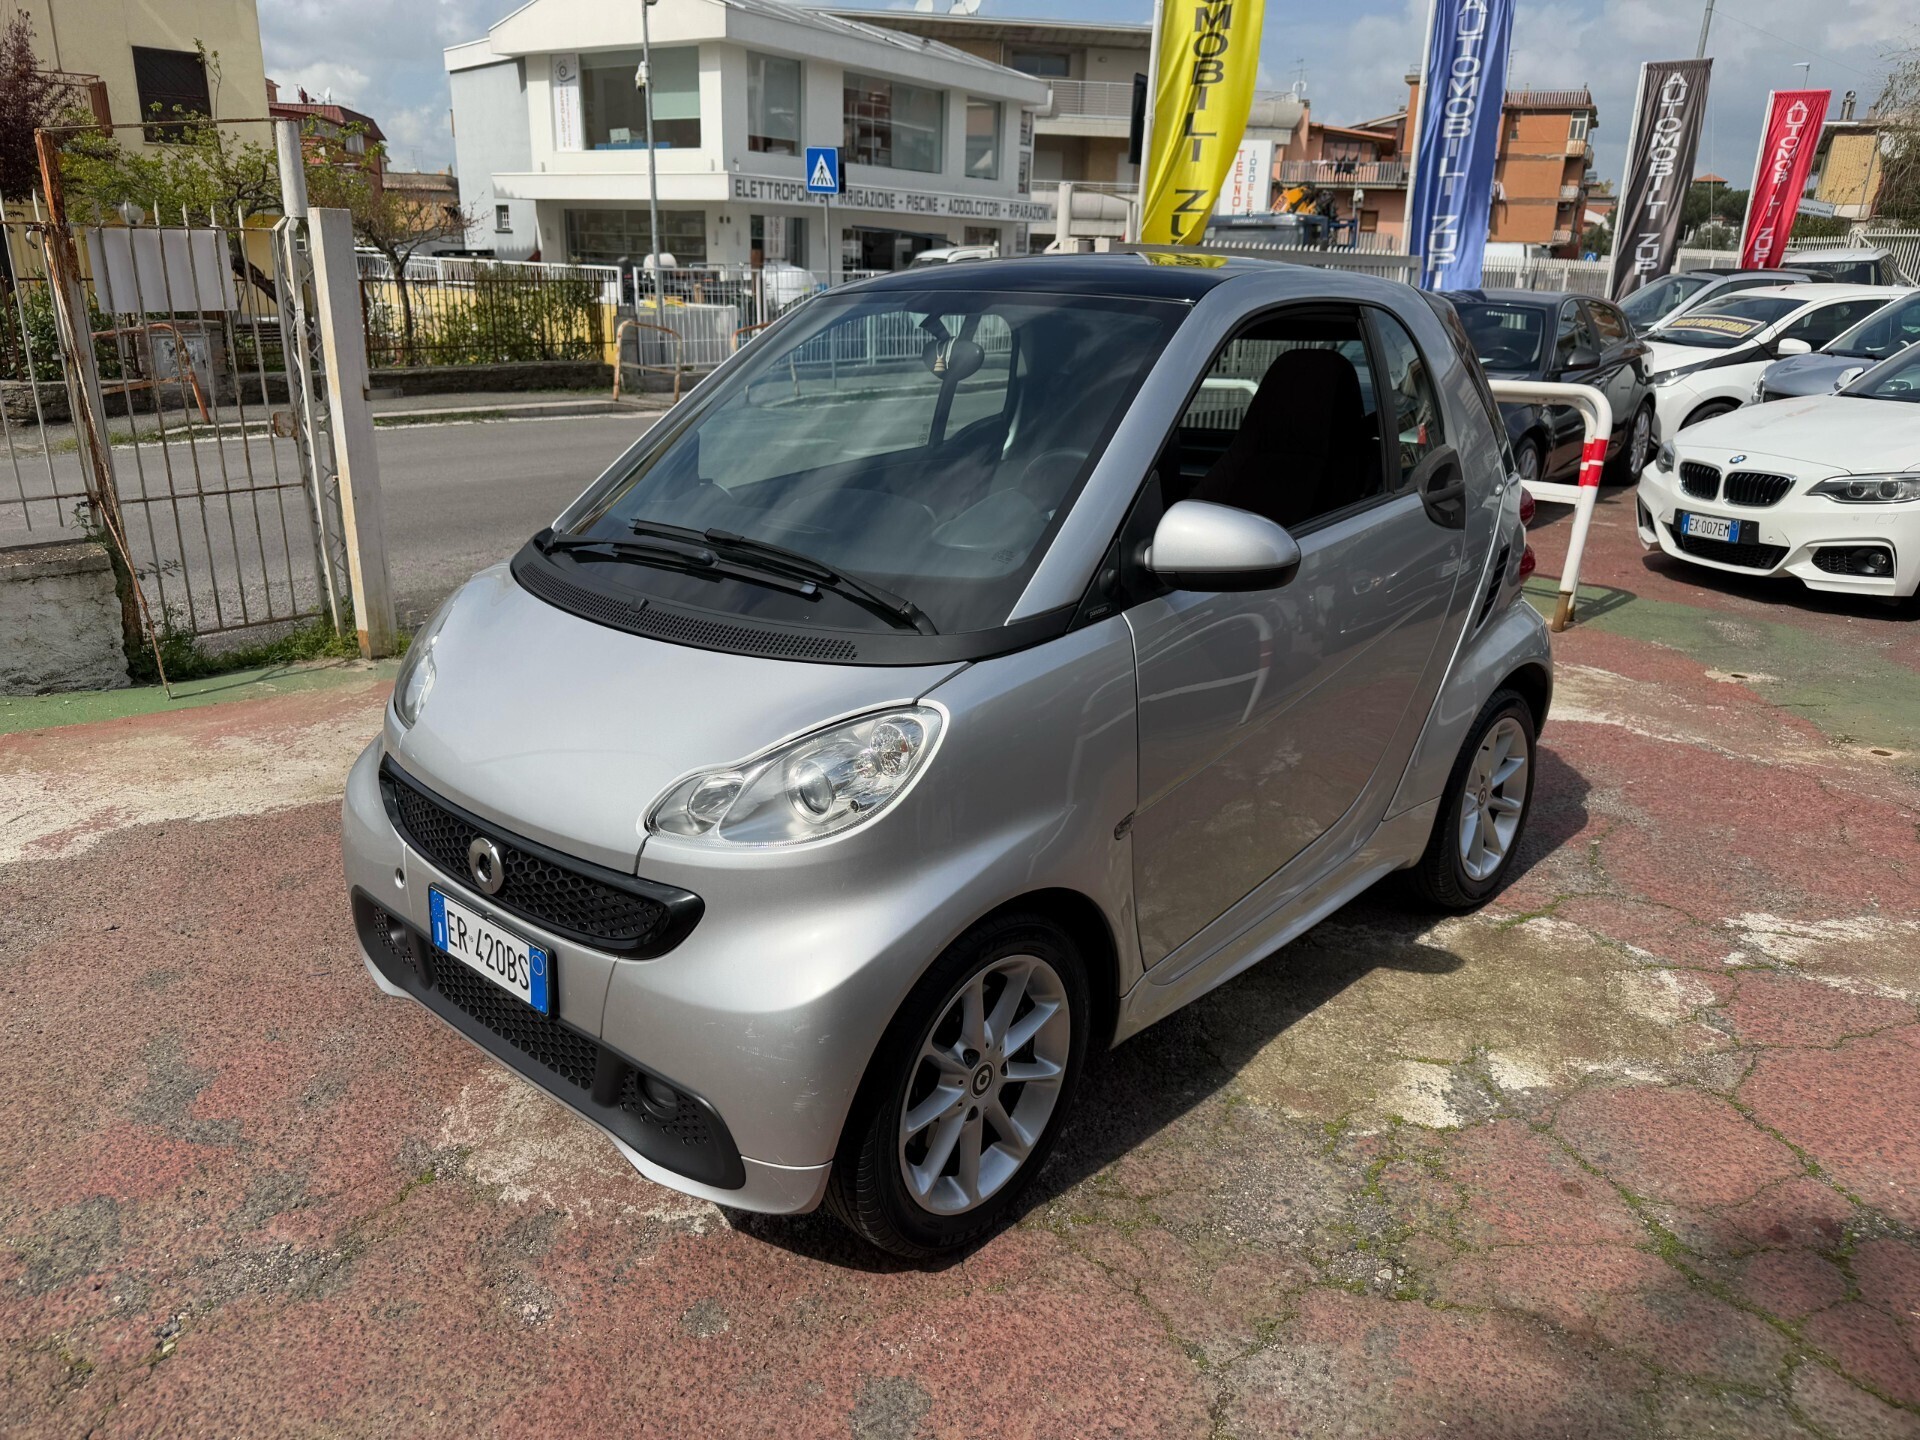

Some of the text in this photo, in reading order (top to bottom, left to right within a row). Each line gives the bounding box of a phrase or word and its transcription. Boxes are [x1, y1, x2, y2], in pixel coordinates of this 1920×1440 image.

[1170, 0, 1233, 245] MOBILI ZU
[1438, 0, 1488, 196] AUTOMOBILI
[1645, 72, 1688, 220] AUTOMOBILI
[838, 190, 895, 209] IRRIGAZIONE
[906, 194, 938, 212] PISCINE
[948, 199, 1000, 217] ADDOLCITORI
[1008, 204, 1049, 221] RIPARAZIONI
[1689, 518, 1730, 537] EX 007EM
[446, 909, 530, 991] ER 420BS
